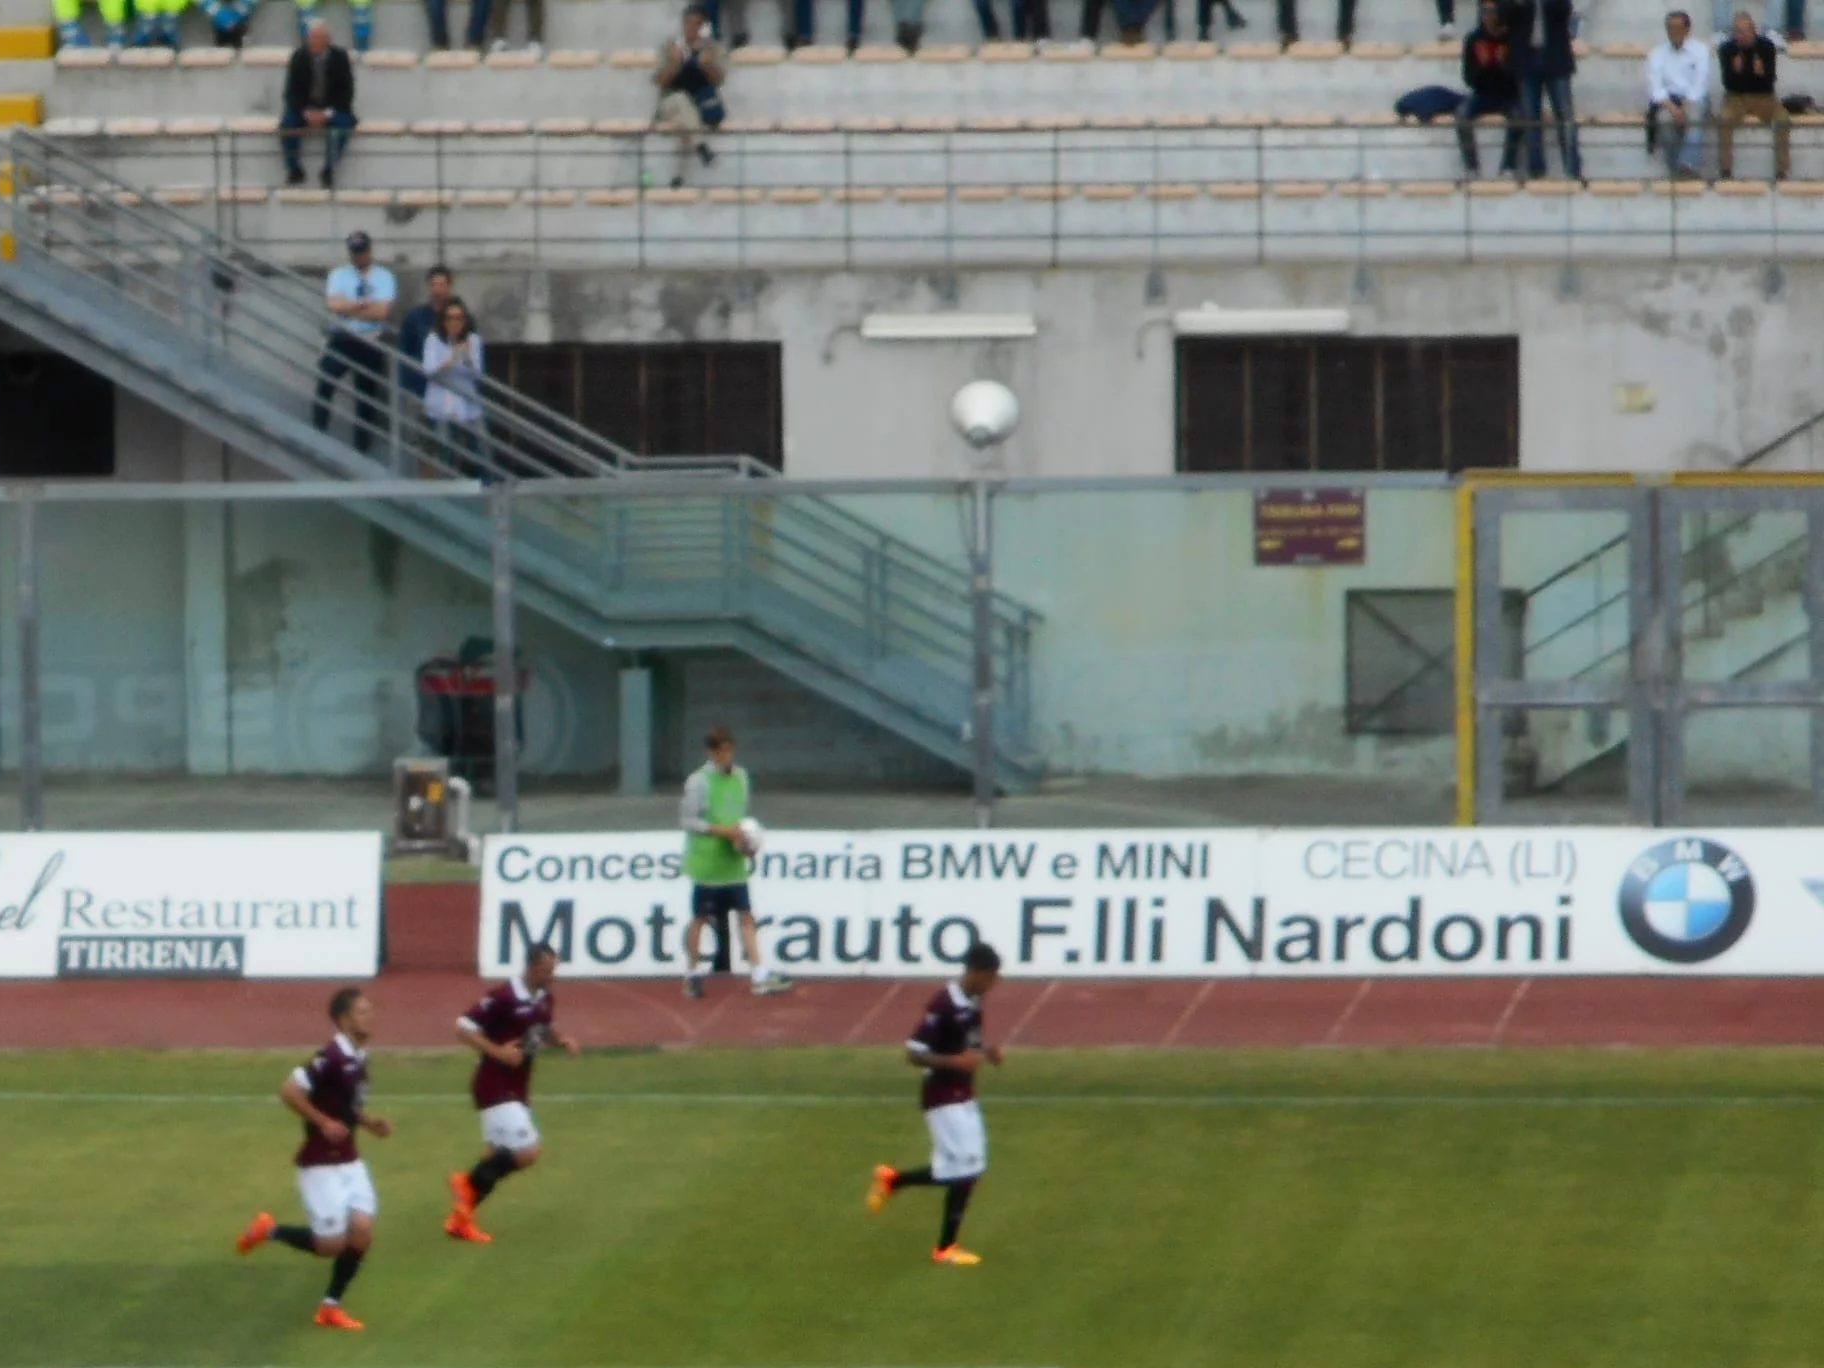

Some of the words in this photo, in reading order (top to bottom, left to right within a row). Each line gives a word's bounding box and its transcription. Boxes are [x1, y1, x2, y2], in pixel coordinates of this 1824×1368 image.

[900, 842, 1037, 881] BMW
[1050, 851, 1079, 881] e
[1095, 841, 1210, 880] MINI
[1302, 839, 1495, 881] CECINA
[1507, 838, 1578, 886] (LI)
[60, 886, 359, 931] Restaurant
[1018, 897, 1165, 963] F.lli
[1203, 895, 1572, 965] Nardoni
[62, 939, 240, 970] TIRRENIA
